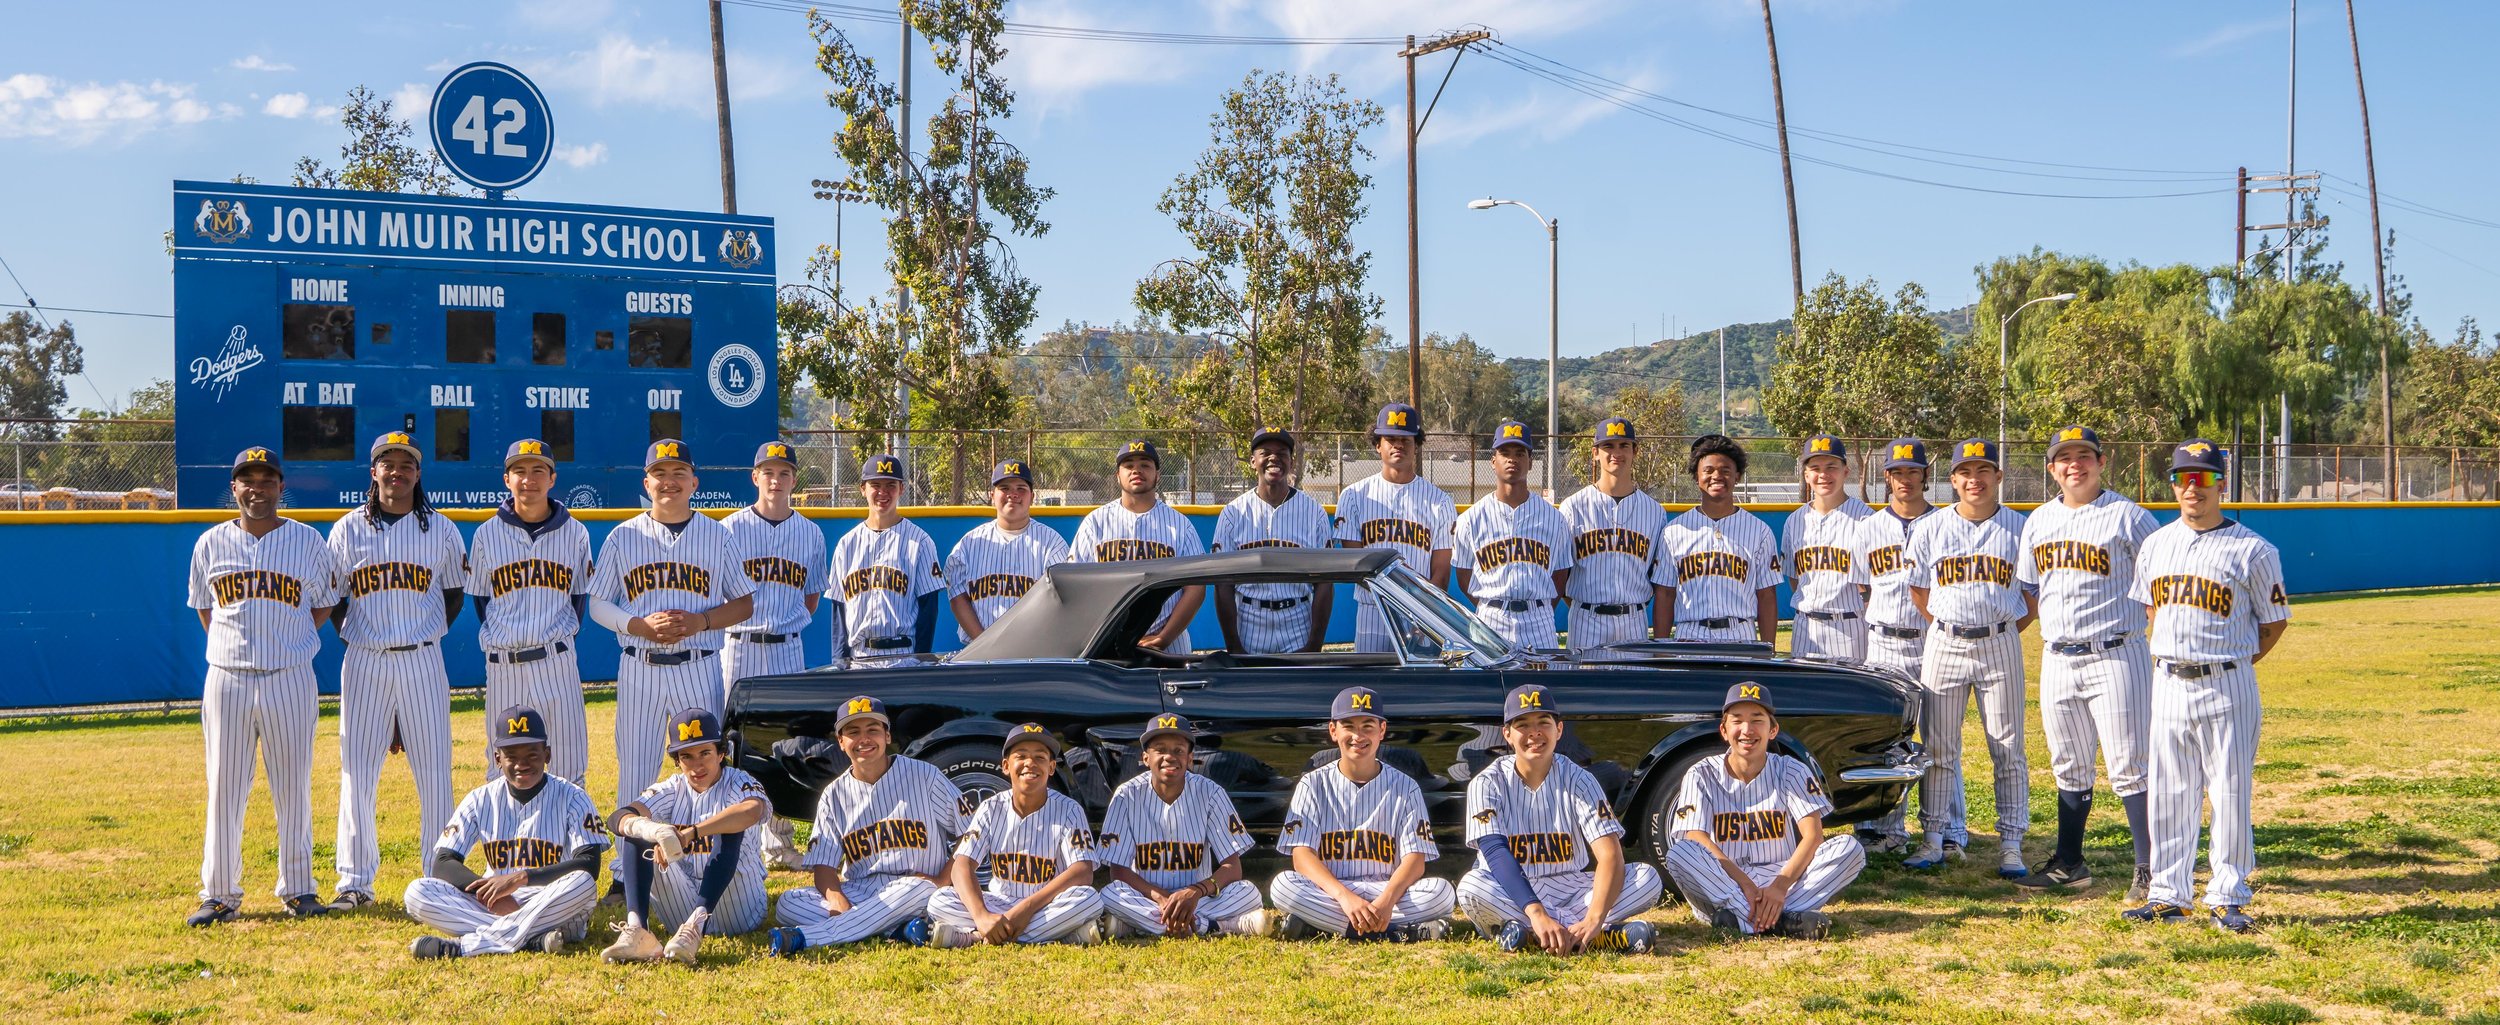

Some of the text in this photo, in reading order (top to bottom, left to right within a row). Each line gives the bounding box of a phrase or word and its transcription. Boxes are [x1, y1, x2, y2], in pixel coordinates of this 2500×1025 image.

[452, 95, 527, 158] 42
[213, 212, 234, 232] M
[267, 206, 706, 264] JOHN MUIR HIGH SCHOOL
[732, 240, 749, 258] M
[291, 278, 348, 302] HOME
[439, 284, 505, 308] INNING
[625, 291, 693, 315] GUESTS
[189, 344, 264, 385] Dodgers
[711, 348, 762, 381] LOS ANGELES DODGERS
[728, 363, 745, 388] LA
[283, 382, 355, 405] AT BAT
[431, 384, 475, 407] BALL
[526, 386, 590, 409] STRIKE
[647, 389, 683, 410] OUT
[715, 386, 758, 404] FOUNDATION
[1386, 411, 1407, 426] M
[1606, 422, 1626, 436] M
[387, 433, 410, 445] M
[1503, 425, 1523, 438] M
[2059, 428, 2083, 442] M
[247, 449, 267, 462] M
[518, 441, 542, 455] M
[656, 442, 679, 458] M
[766, 444, 787, 458] M
[1128, 442, 1145, 452] M
[1810, 438, 1831, 452] M
[1892, 444, 1914, 459] M
[1963, 442, 1986, 457] M
[876, 460, 893, 474] M
[1003, 463, 1021, 475] M
[339, 491, 510, 503] HEL WILL WEBST
[570, 484, 597, 493] PASADENA
[689, 491, 732, 500] ASADENA
[1475, 537, 1550, 573] MUSTANGS
[1574, 528, 1650, 561] MUSTANGS
[1677, 551, 1749, 584] MUSTANGS
[1795, 545, 1850, 576] USTANG
[1936, 554, 2014, 589] MUSTANGS
[349, 561, 433, 598] MUSTANGS
[491, 558, 573, 598] MUSTANGS
[623, 561, 710, 602] MUSTANGS
[743, 556, 808, 590] USTANGS
[841, 565, 909, 601] MUSTANGS
[213, 570, 302, 608] MUSTANGS
[968, 573, 1038, 601] MUSTANG
[1351, 694, 1372, 709] M
[1519, 691, 1541, 708] M
[1739, 685, 1761, 700] M
[848, 698, 873, 715] M
[508, 717, 530, 734] M
[678, 719, 703, 741] M
[1023, 725, 1044, 733] M
[1157, 717, 1178, 729] M
[942, 760, 1004, 775] oodrich
[583, 812, 607, 835] 42
[1714, 810, 1786, 843] USTANG
[1071, 828, 1095, 851] 42
[1508, 832, 1574, 865] USTANG
[1651, 813, 1668, 869] dial T/A
[483, 838, 564, 870] USTANGS
[1136, 841, 1204, 872] USTANG
[992, 853, 1057, 884] USTANGS
